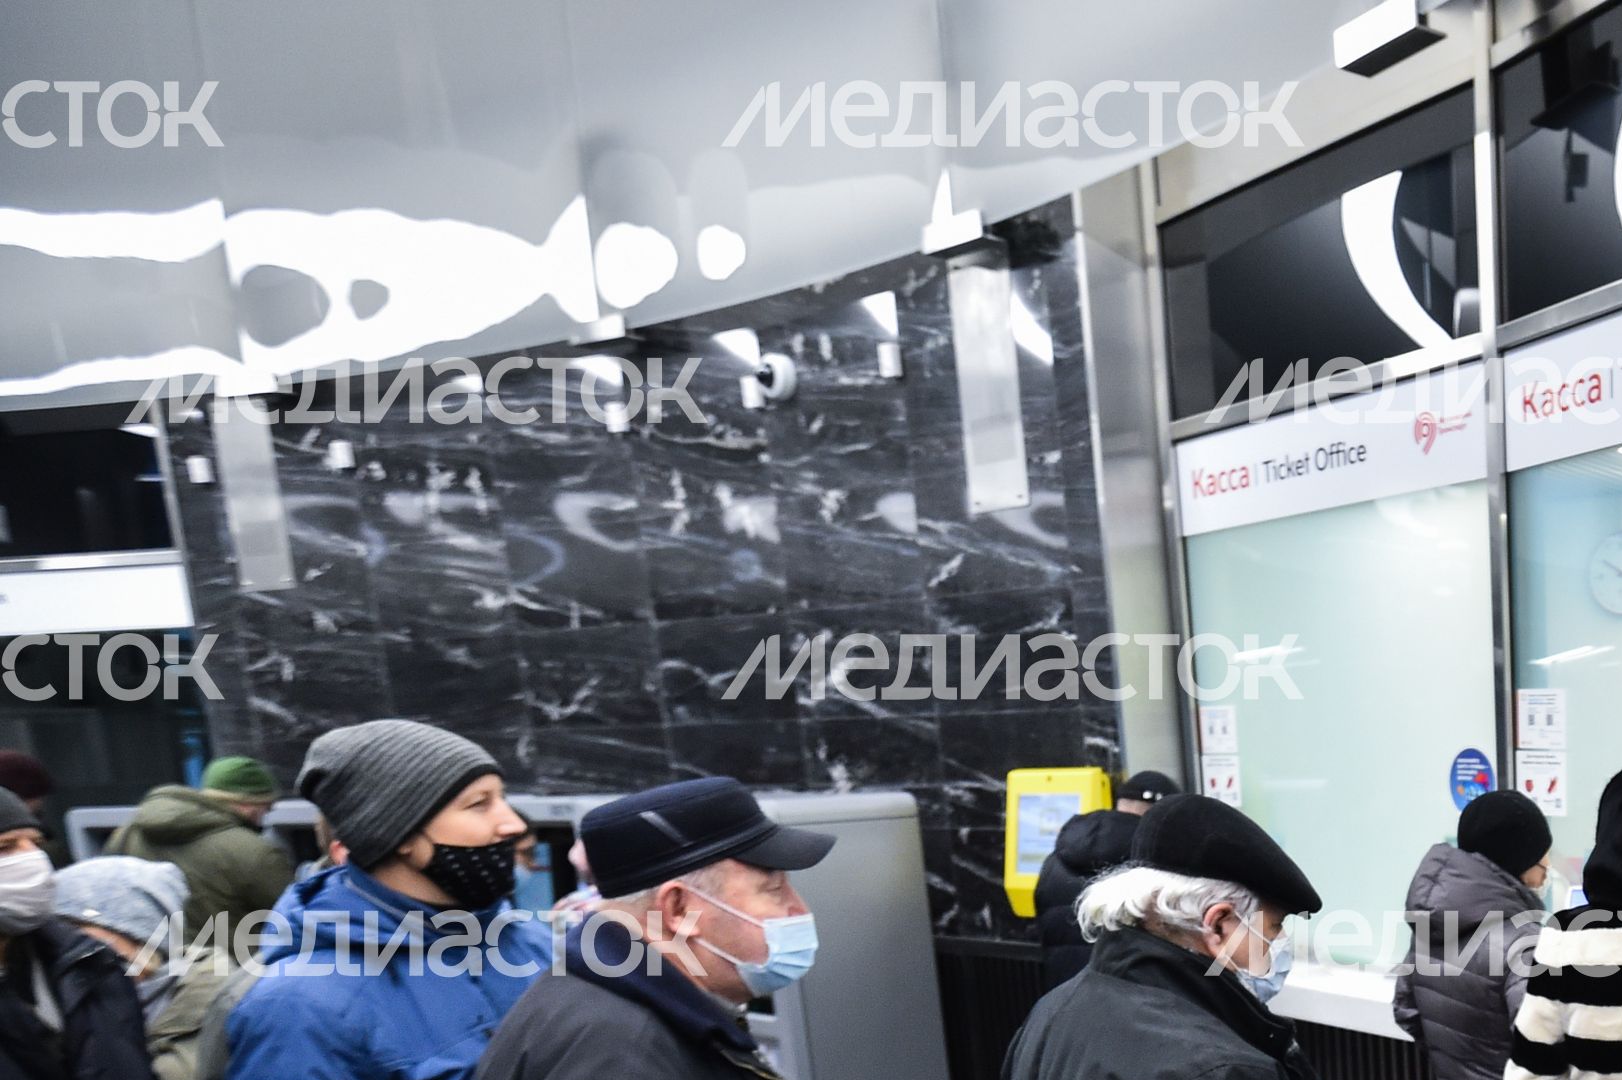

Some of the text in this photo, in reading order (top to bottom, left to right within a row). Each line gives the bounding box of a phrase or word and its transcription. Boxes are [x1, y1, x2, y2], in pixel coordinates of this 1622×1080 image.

[1521, 372, 1602, 423] Касса
[1190, 441, 1368, 500] Касса Ticket Office
